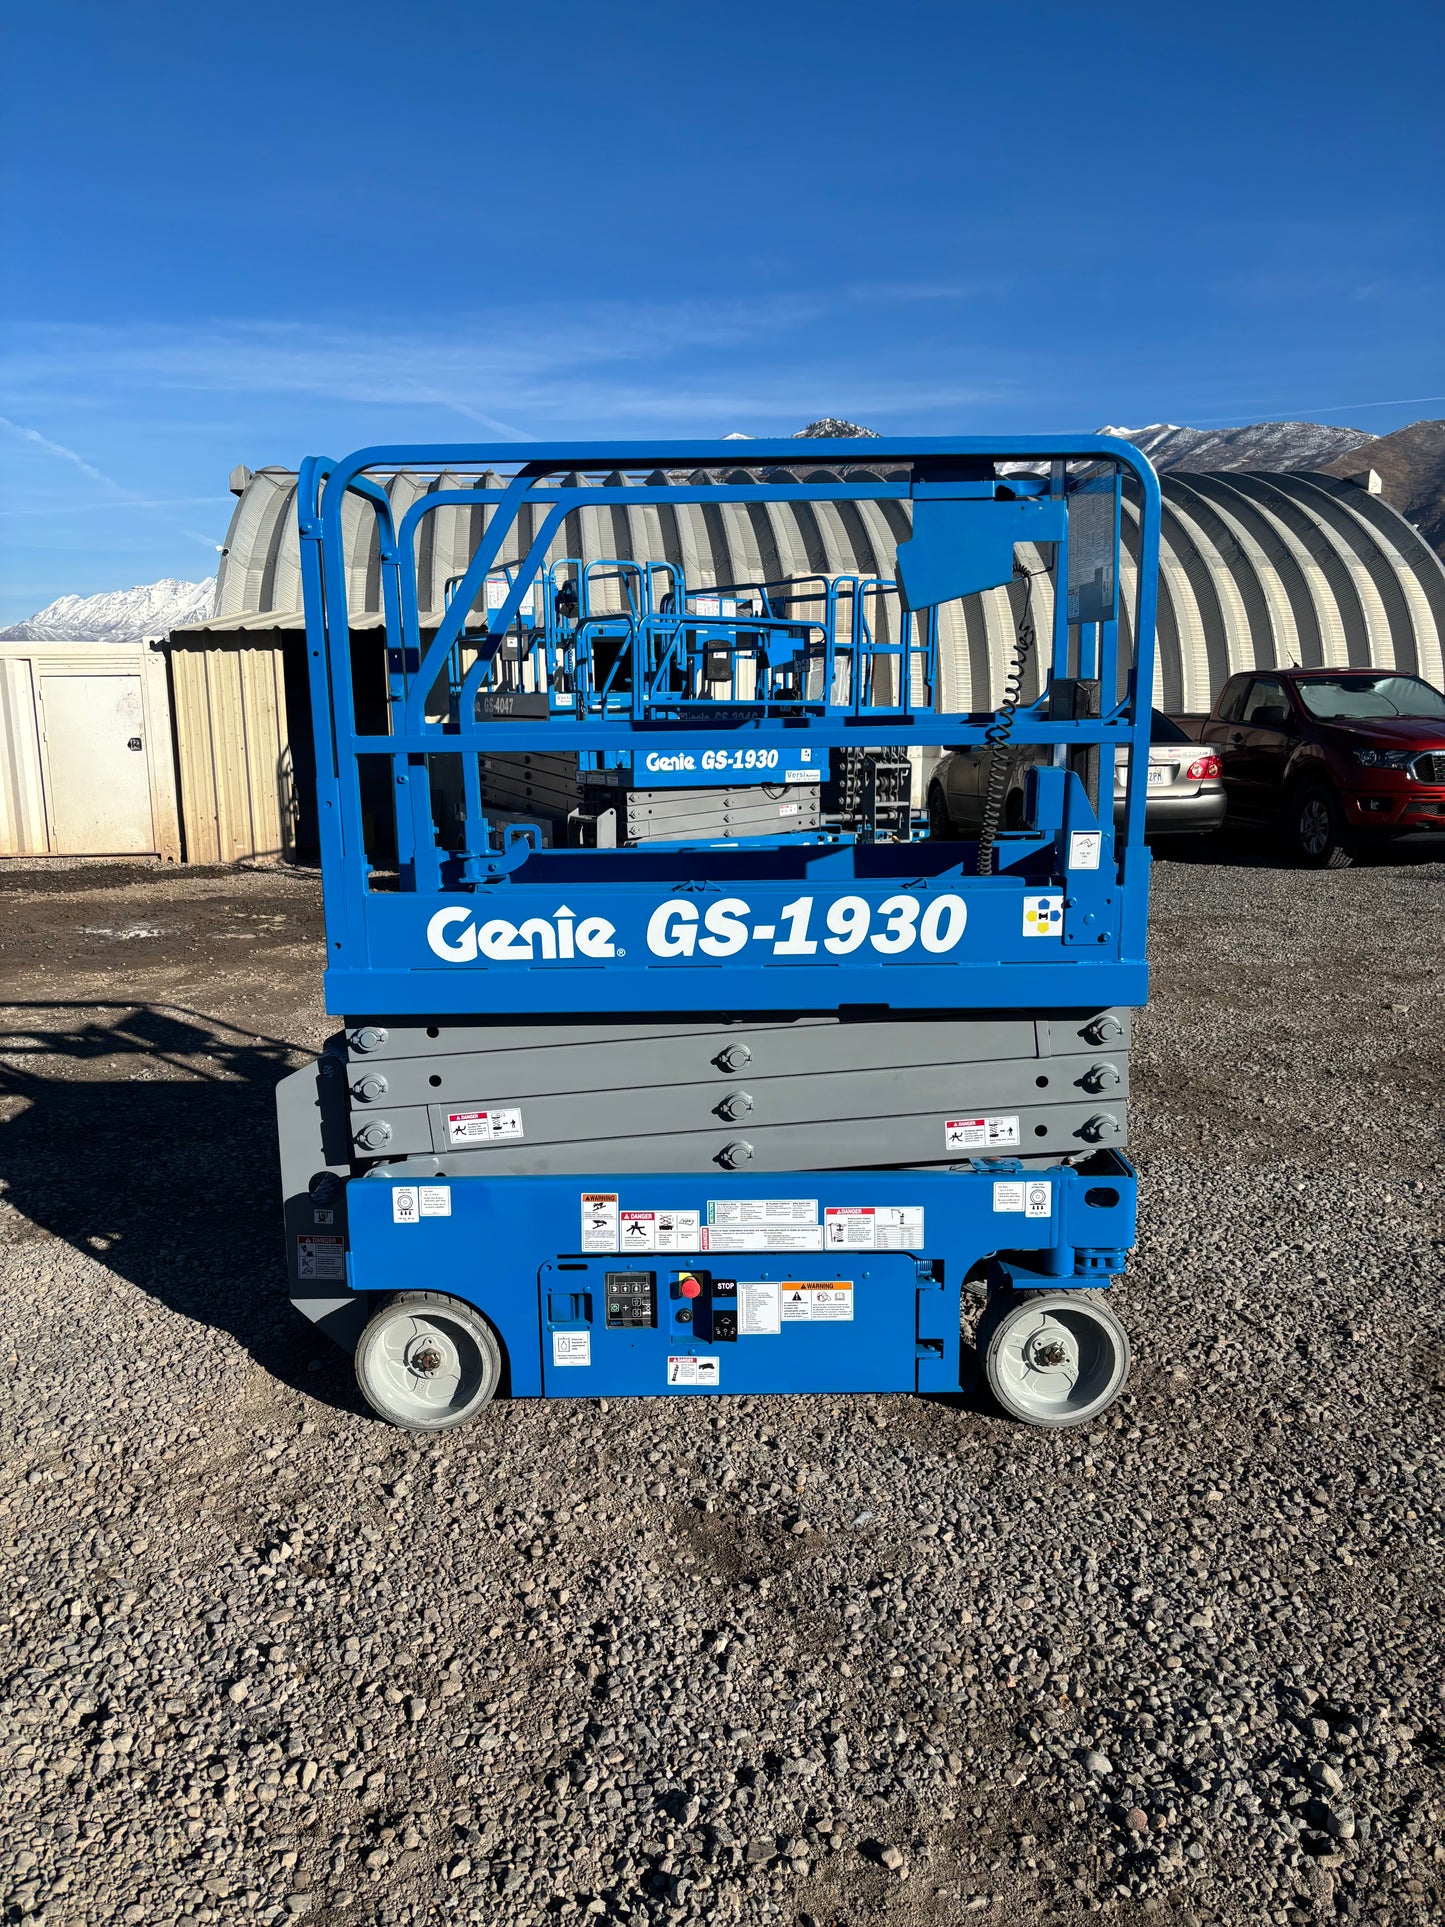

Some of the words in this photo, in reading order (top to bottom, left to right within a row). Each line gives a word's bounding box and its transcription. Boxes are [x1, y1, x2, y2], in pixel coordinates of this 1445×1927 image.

[484, 697, 514, 714] GS-4047
[646, 752, 695, 771] Genie
[701, 749, 779, 770] GS-1930
[646, 894, 968, 959] GS-1930
[590, 1194, 615, 1202] WARNING
[717, 1282, 735, 1290] STOP
[806, 1282, 834, 1290] WARNING
